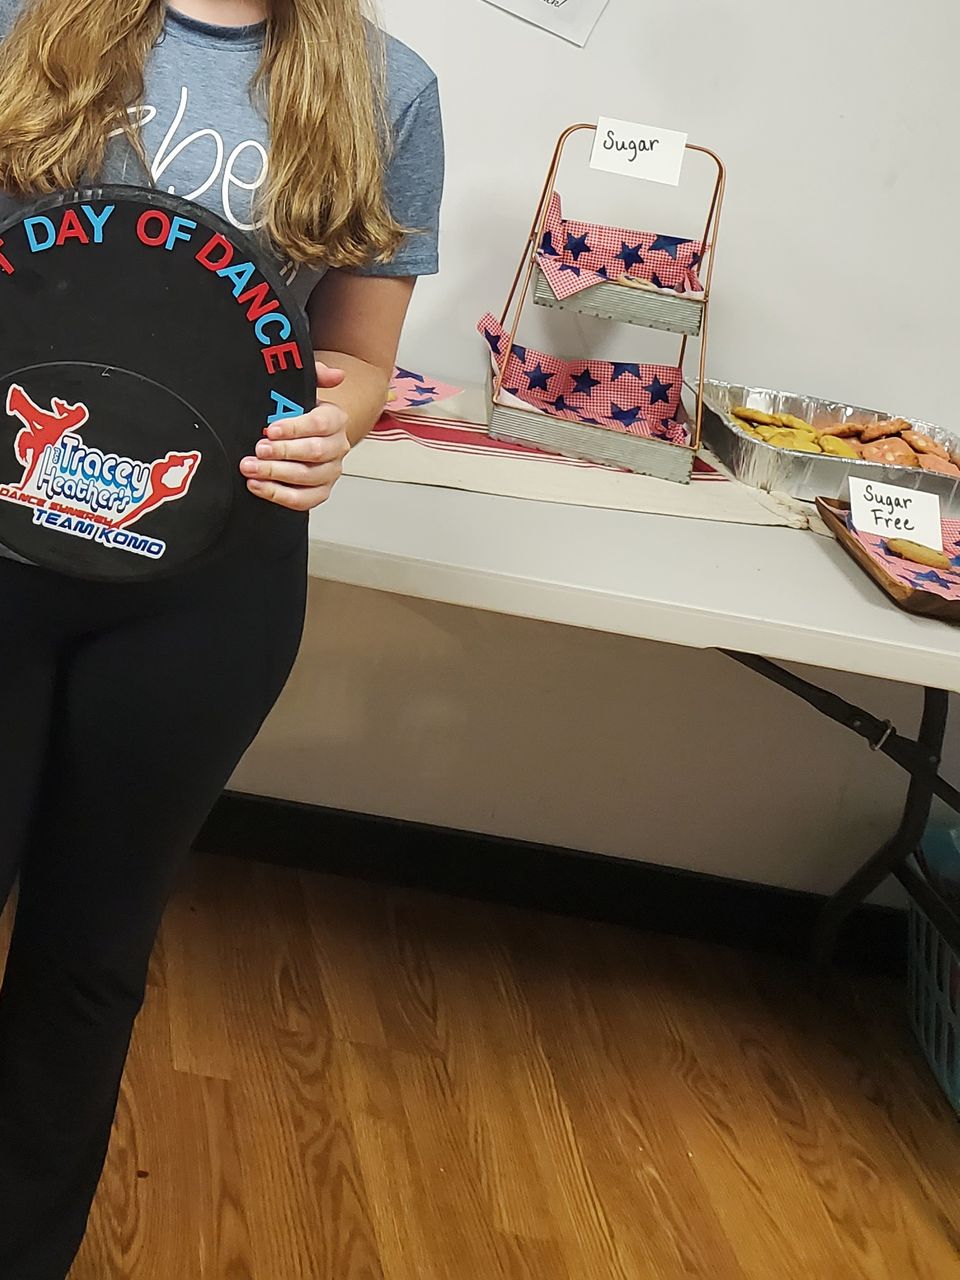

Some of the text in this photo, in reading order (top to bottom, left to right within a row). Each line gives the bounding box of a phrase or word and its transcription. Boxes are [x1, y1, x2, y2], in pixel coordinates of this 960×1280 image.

[603, 130, 660, 162] Sugar
[23, 204, 115, 252] DAY
[136, 209, 197, 251] OF
[195, 232, 304, 374] DANCE
[263, 390, 305, 432] A
[37, 444, 130, 513] Heather's
[60, 435, 151, 503] Tracey
[863, 484, 913, 515] Sugar
[870, 509, 915, 531] Free
[35, 509, 164, 555] TEAM KOMO
